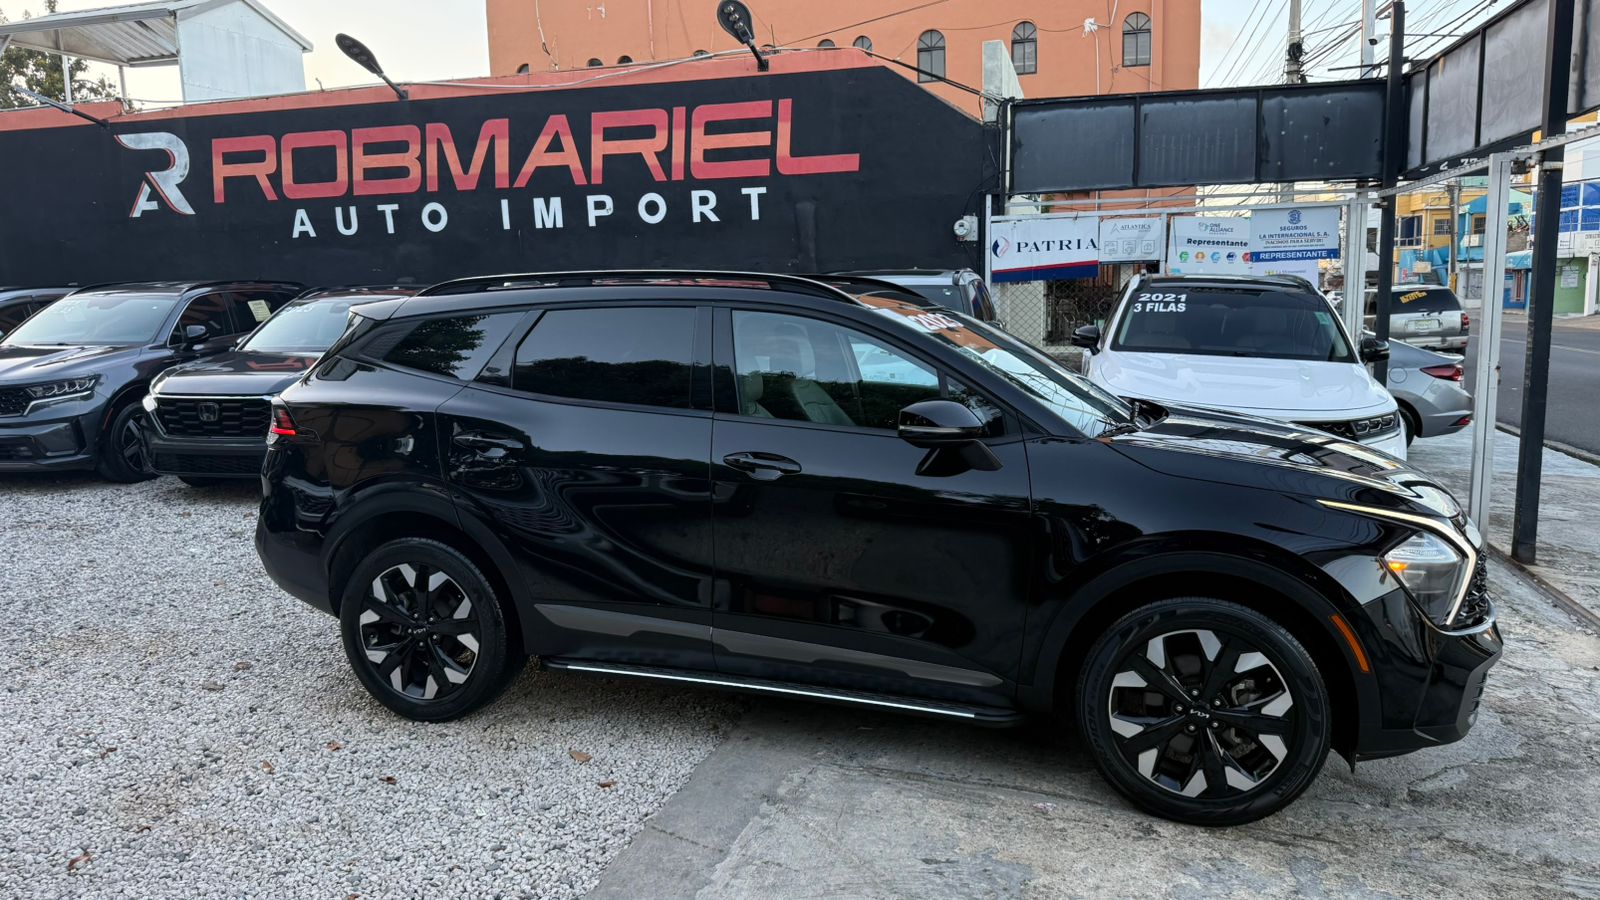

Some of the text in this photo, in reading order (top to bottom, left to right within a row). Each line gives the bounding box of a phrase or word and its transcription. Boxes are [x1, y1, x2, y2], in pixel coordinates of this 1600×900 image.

[211, 97, 860, 204] ROBMARIEL
[292, 186, 768, 239] AUTO IMPORT
[1267, 231, 1315, 239] INTERNACIONAL
[1017, 238, 1098, 253] PATRIA
[1186, 237, 1249, 248] Representante
[1259, 250, 1328, 260] REPRESENTANTE
[1137, 293, 1187, 302] 2021
[1133, 302, 1187, 313] 3 FILAS
